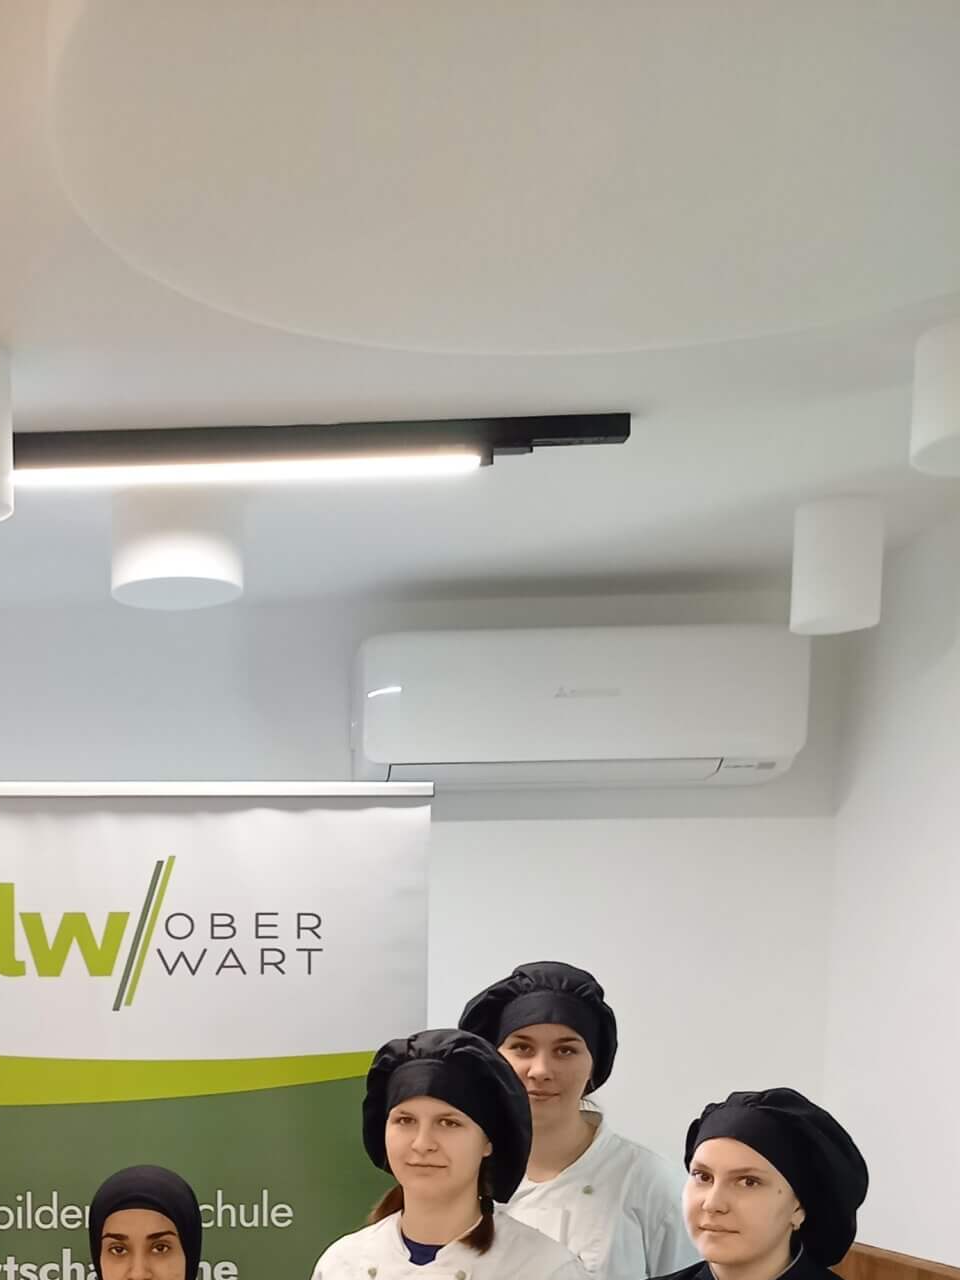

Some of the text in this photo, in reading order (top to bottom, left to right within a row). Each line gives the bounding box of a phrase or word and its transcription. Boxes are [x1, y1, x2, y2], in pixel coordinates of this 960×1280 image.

[164, 912, 323, 940] OBER
[156, 948, 324, 976] WART
[199, 1189, 294, 1228] chule
